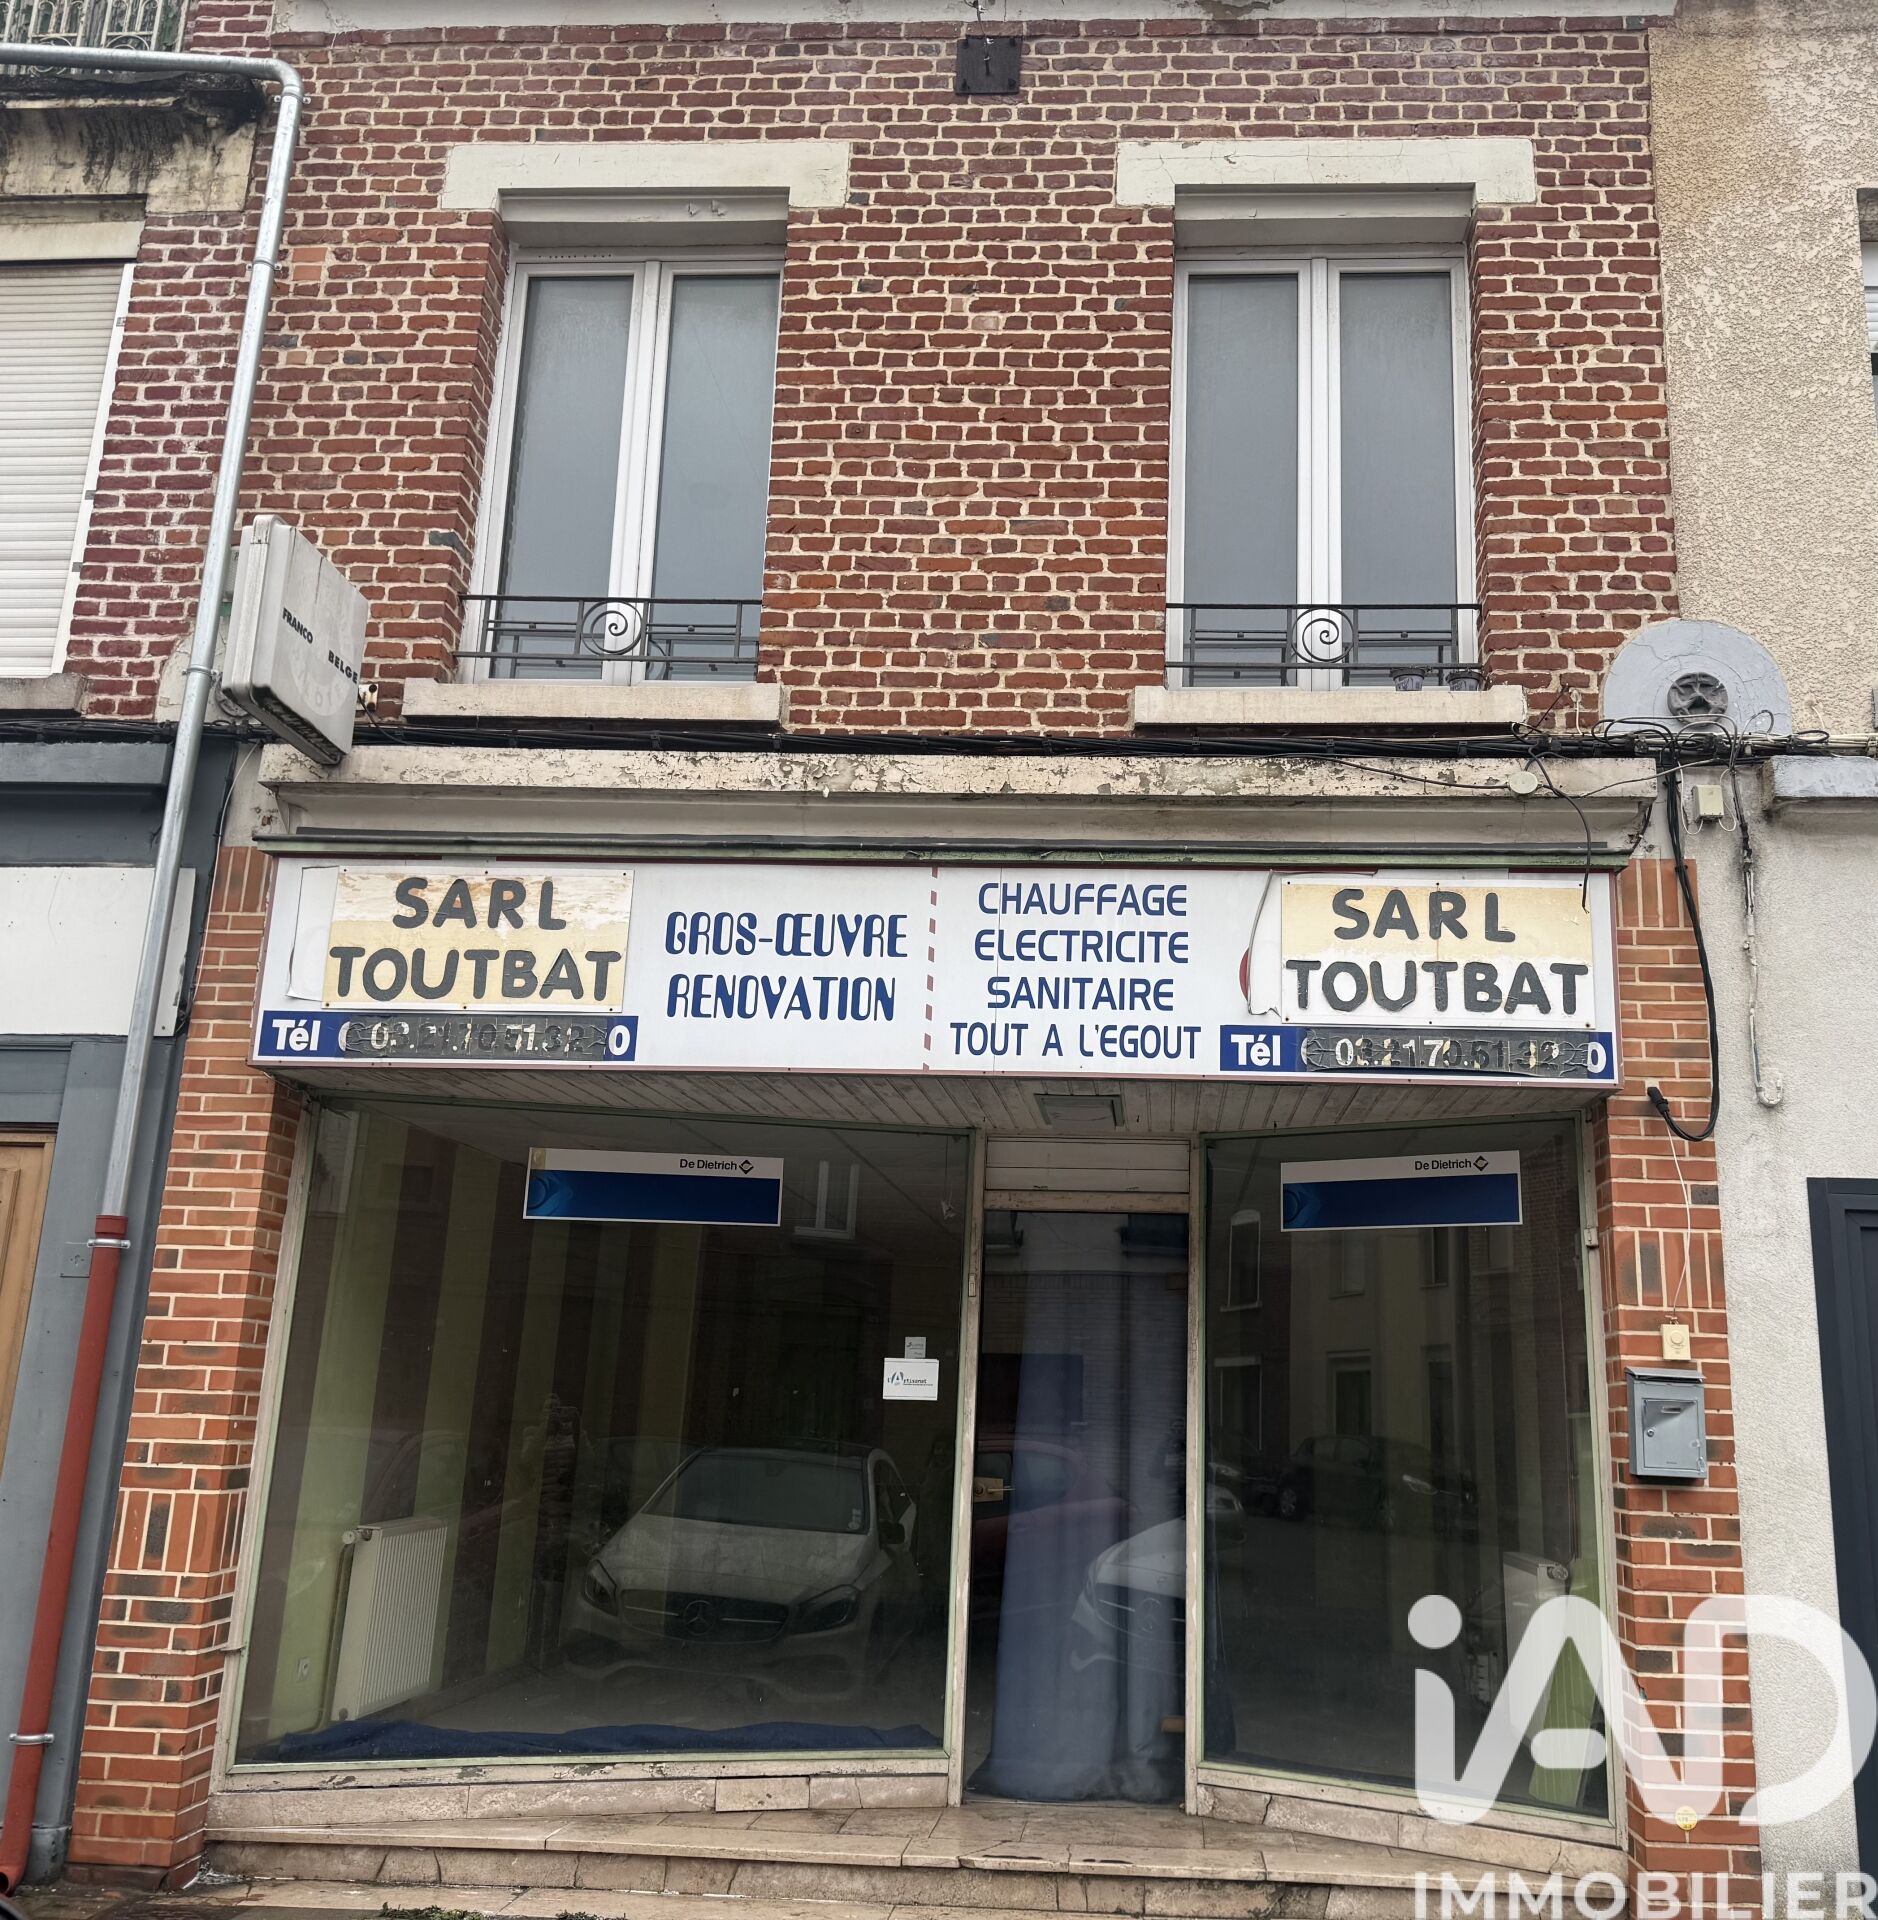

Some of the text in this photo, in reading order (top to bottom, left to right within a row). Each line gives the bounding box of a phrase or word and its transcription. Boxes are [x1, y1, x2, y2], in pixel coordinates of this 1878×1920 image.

[282, 607, 358, 685] FRANCO BELGE
[392, 876, 567, 930] SARL
[978, 882, 1188, 917] CHAUFFAGE
[1332, 888, 1516, 943] SARL
[665, 911, 908, 958] GROS-ŒUVRE
[974, 929, 1189, 964] ELECTRICITE
[329, 945, 622, 1001] TOUTBAT
[1285, 959, 1590, 1015] TOUTBAT
[666, 973, 896, 1022] RENOVATION
[987, 976, 1174, 1011] SANITAIRE
[271, 1018, 321, 1051] Tél
[950, 1022, 1202, 1059] TOUT A L'EGOUT
[1230, 1033, 1281, 1067] Tél
[679, 1158, 738, 1172] De Dietrich
[1414, 1158, 1472, 1171] De Dietrich
